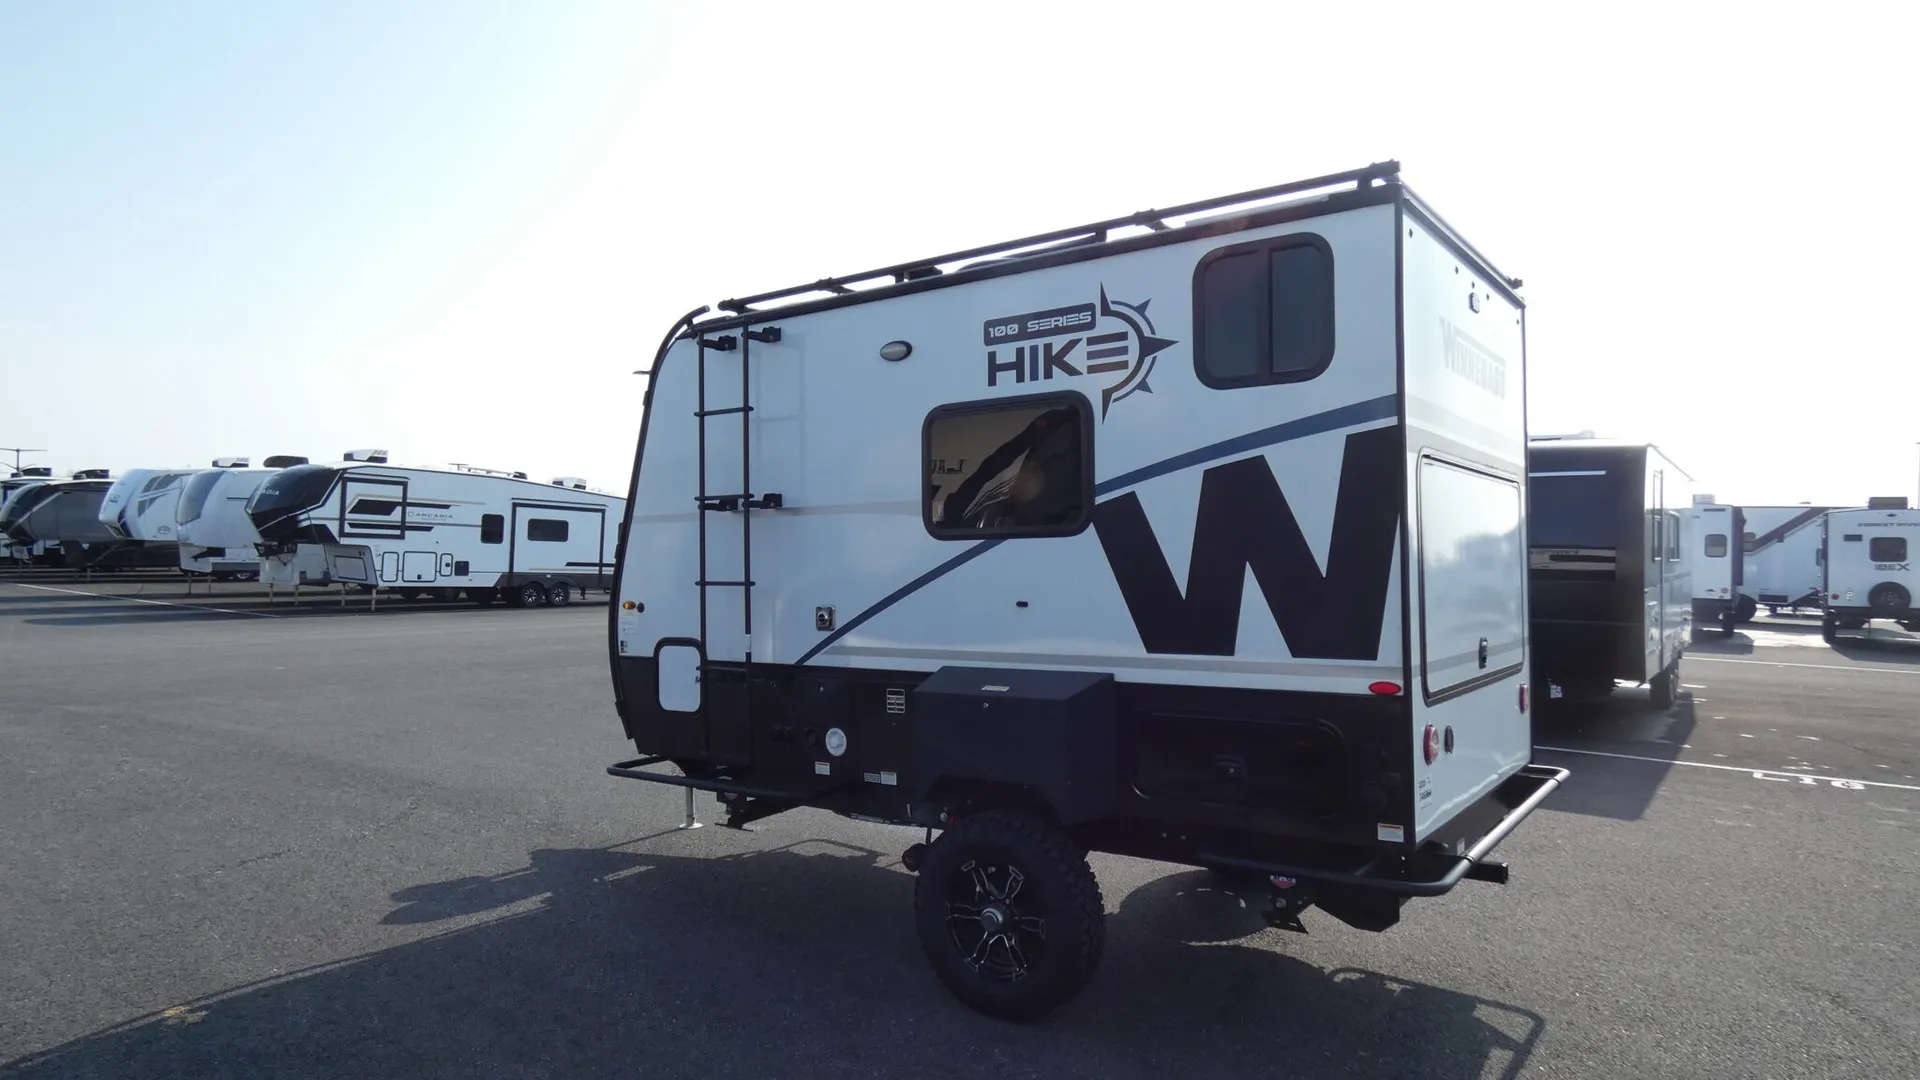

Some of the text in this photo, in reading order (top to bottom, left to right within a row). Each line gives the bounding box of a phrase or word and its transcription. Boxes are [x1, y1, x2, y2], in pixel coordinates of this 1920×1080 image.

[988, 311, 1092, 338] 100 SERIES
[987, 331, 1129, 387] HIKE
[1092, 424, 1400, 661] W
[1874, 563, 1910, 571] IBEX
